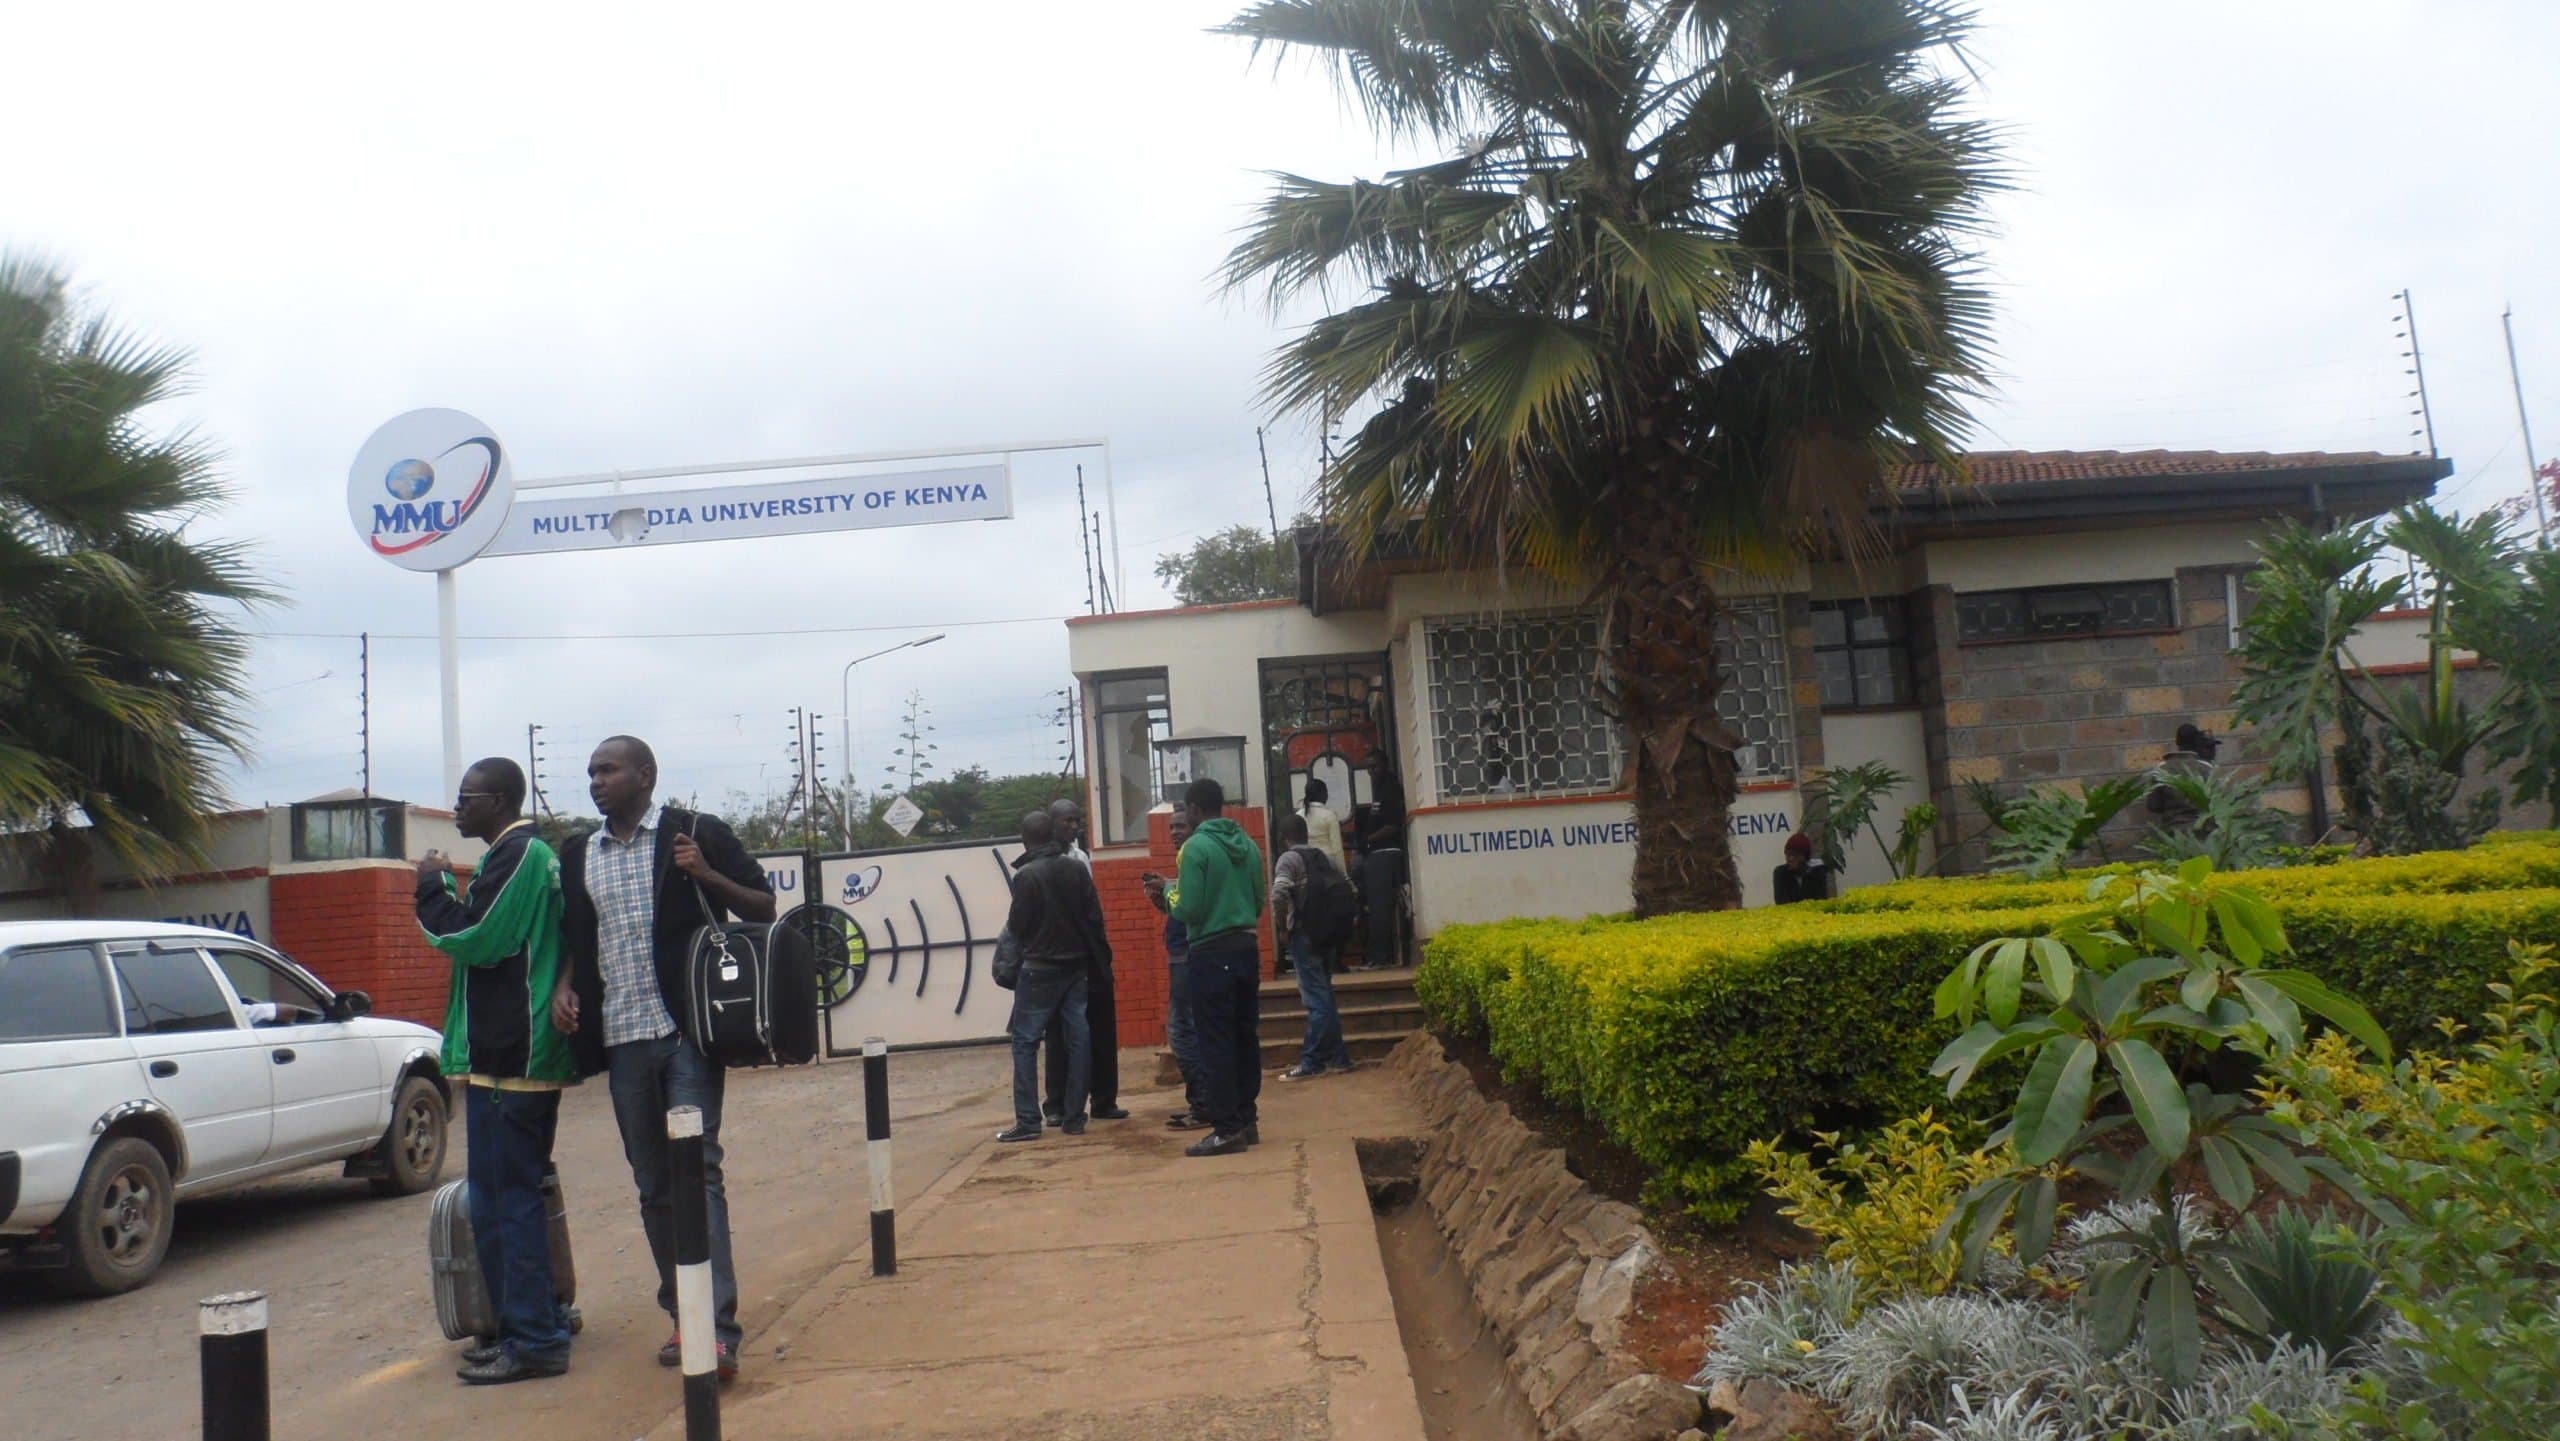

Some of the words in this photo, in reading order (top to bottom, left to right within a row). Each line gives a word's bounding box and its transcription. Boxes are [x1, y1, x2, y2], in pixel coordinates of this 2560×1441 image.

[372, 500, 462, 534] MMU
[533, 507, 693, 535] MULTIDIA
[701, 493, 856, 522] UNIVERSITY
[863, 490, 896, 510] OF
[904, 483, 988, 506] KENYA
[1427, 828, 1554, 855] MULTIMEDIA
[1563, 822, 1637, 847] UNIVER
[842, 886, 872, 899] MMU
